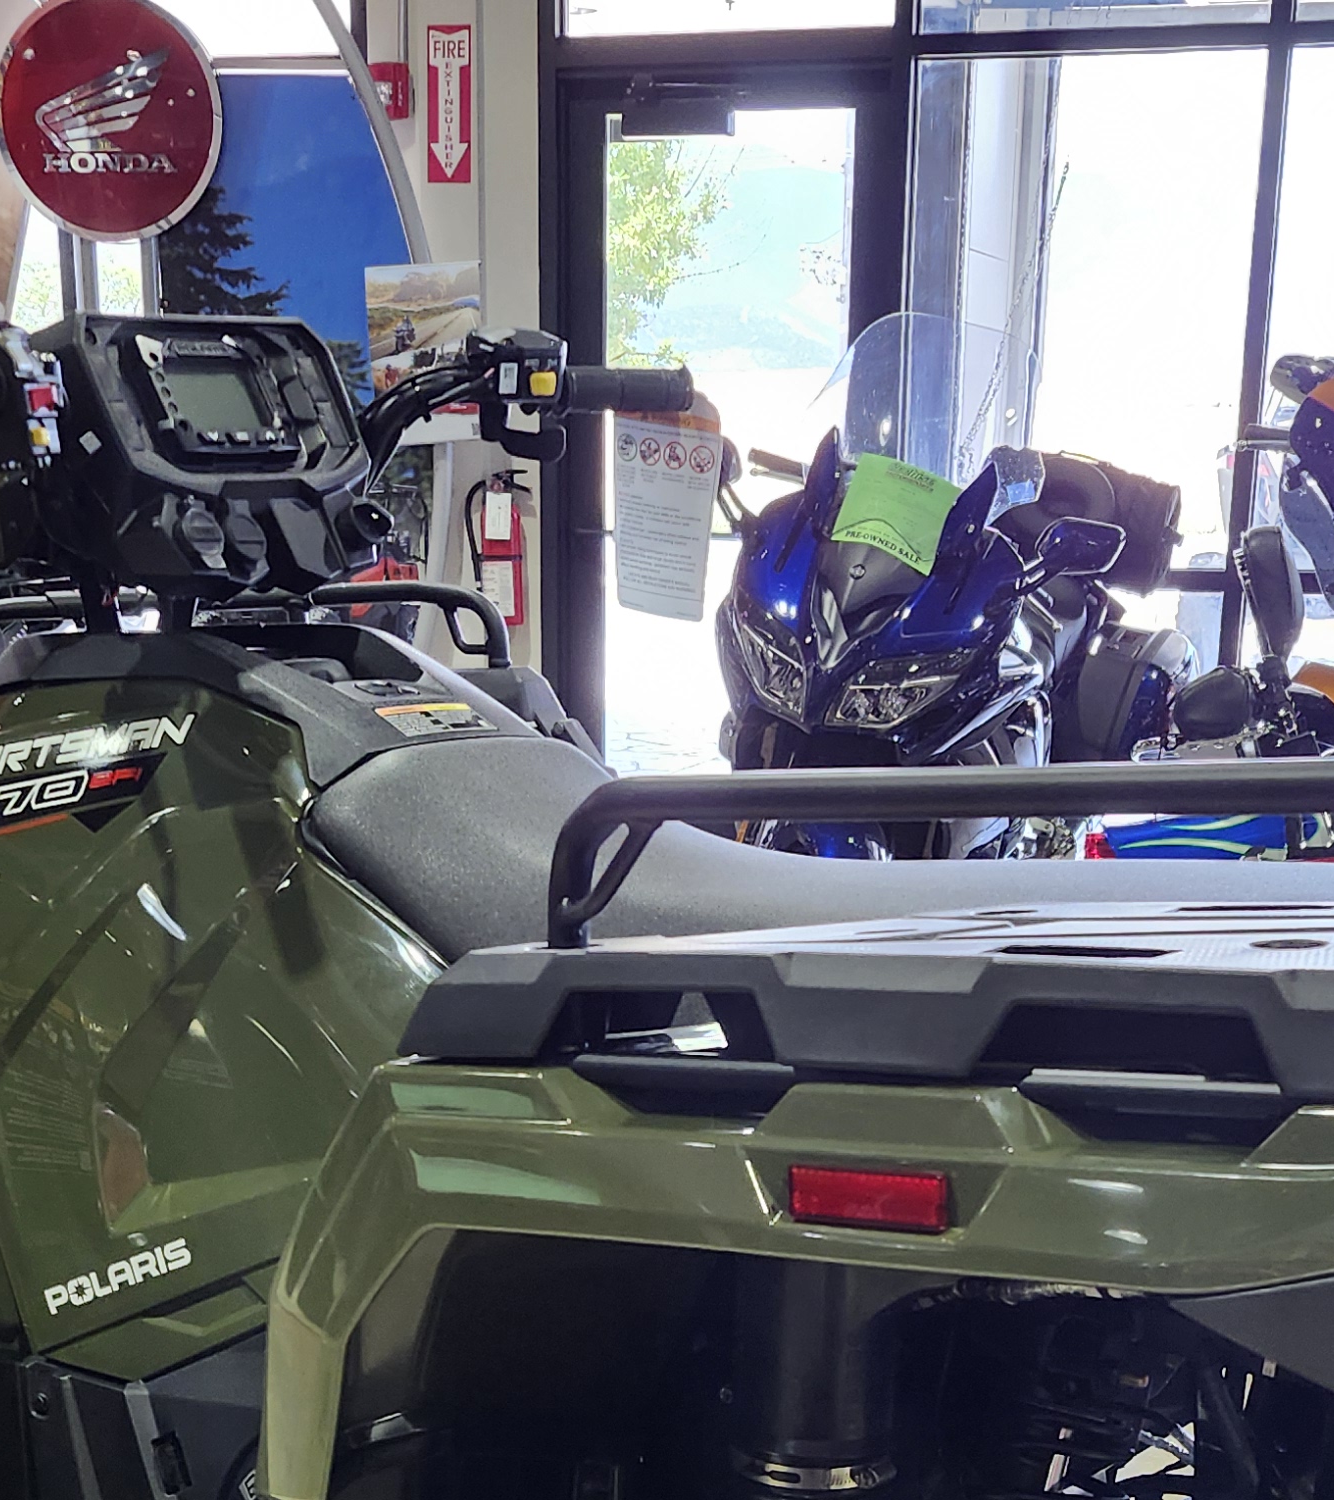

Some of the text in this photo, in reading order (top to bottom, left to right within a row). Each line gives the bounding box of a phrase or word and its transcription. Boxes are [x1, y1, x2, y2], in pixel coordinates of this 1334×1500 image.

[432, 40, 466, 59] FIRE
[443, 61, 454, 169] EXTINGUISHER
[42, 152, 178, 174] HONDA
[844, 530, 897, 552] PRE-OWNED
[898, 547, 922, 566] SALE
[43, 1237, 192, 1316] POLARIS
